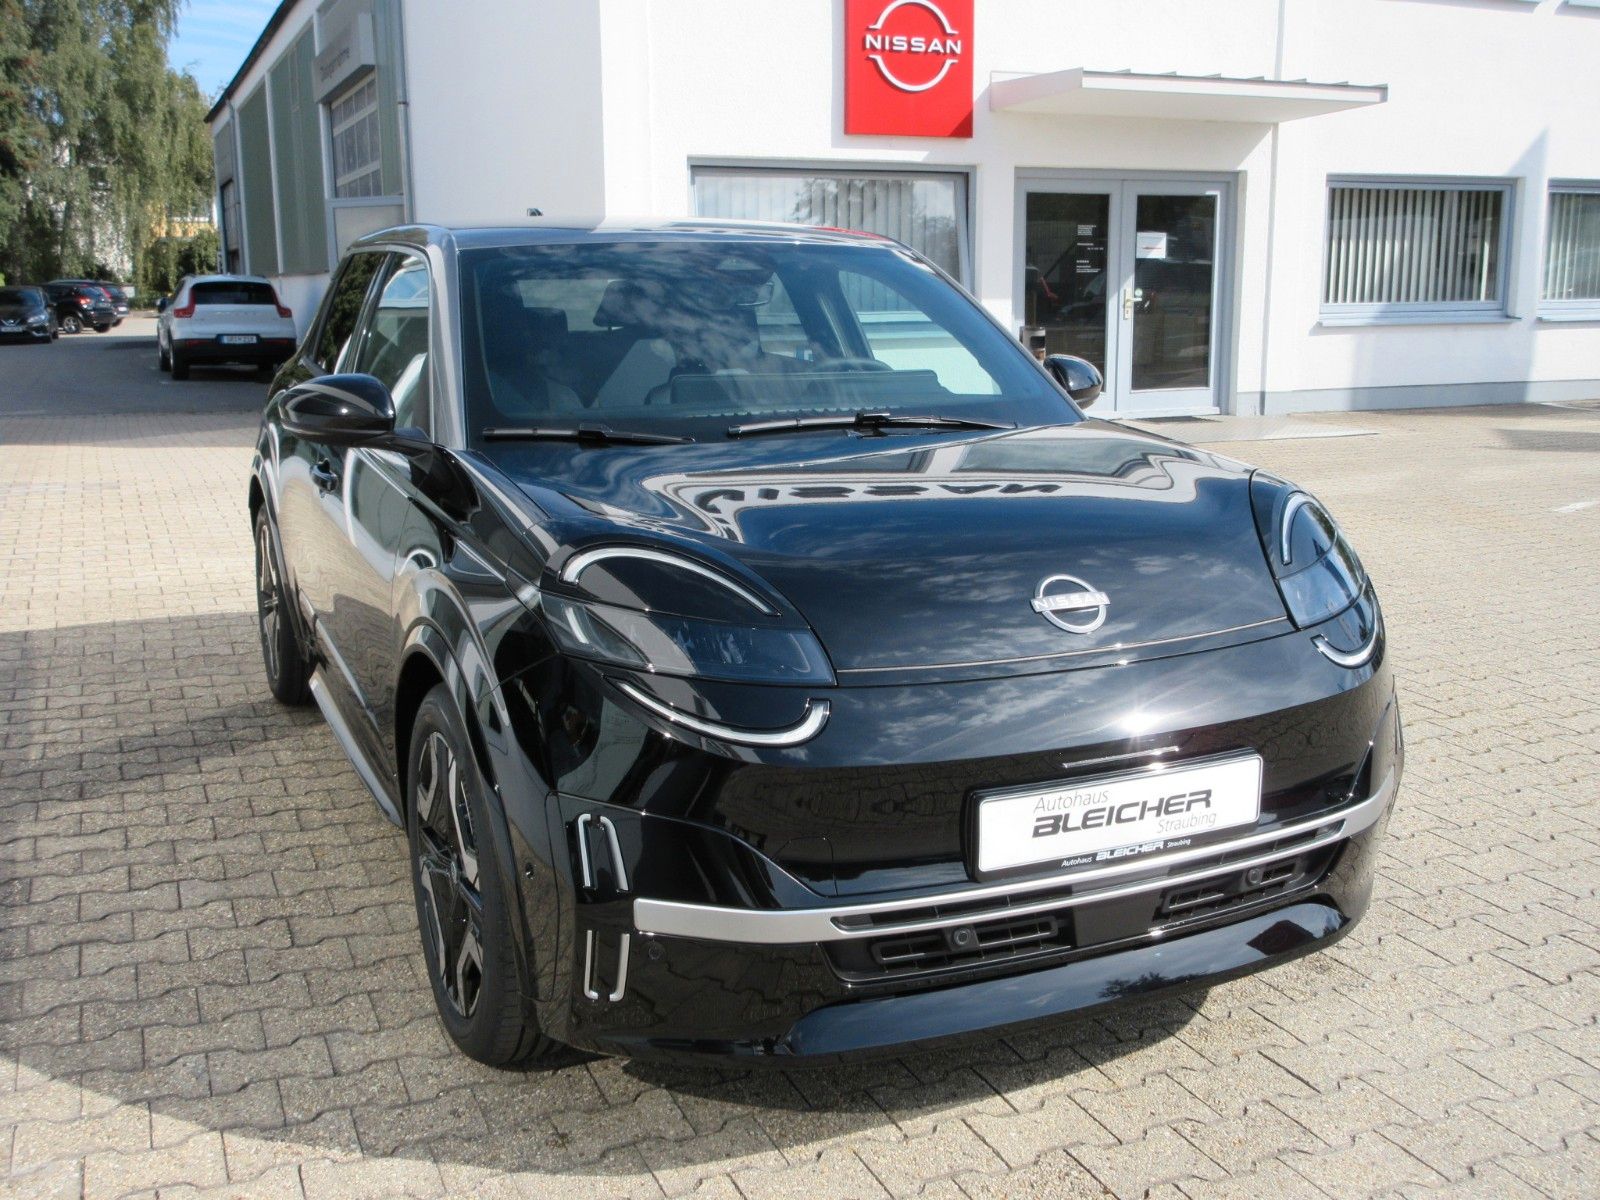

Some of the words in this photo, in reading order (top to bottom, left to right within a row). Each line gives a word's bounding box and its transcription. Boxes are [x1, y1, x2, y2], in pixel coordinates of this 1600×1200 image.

[865, 34, 961, 54] NISSAN
[1033, 593, 1108, 610] NISSAN
[1033, 789, 1109, 814] Autohaus
[1032, 789, 1212, 838] BLEICHER
[1156, 812, 1217, 833] Straubing
[1061, 857, 1092, 867] Autohaus
[1096, 840, 1165, 861] BLEICHER
[1167, 839, 1191, 848] Straubing
